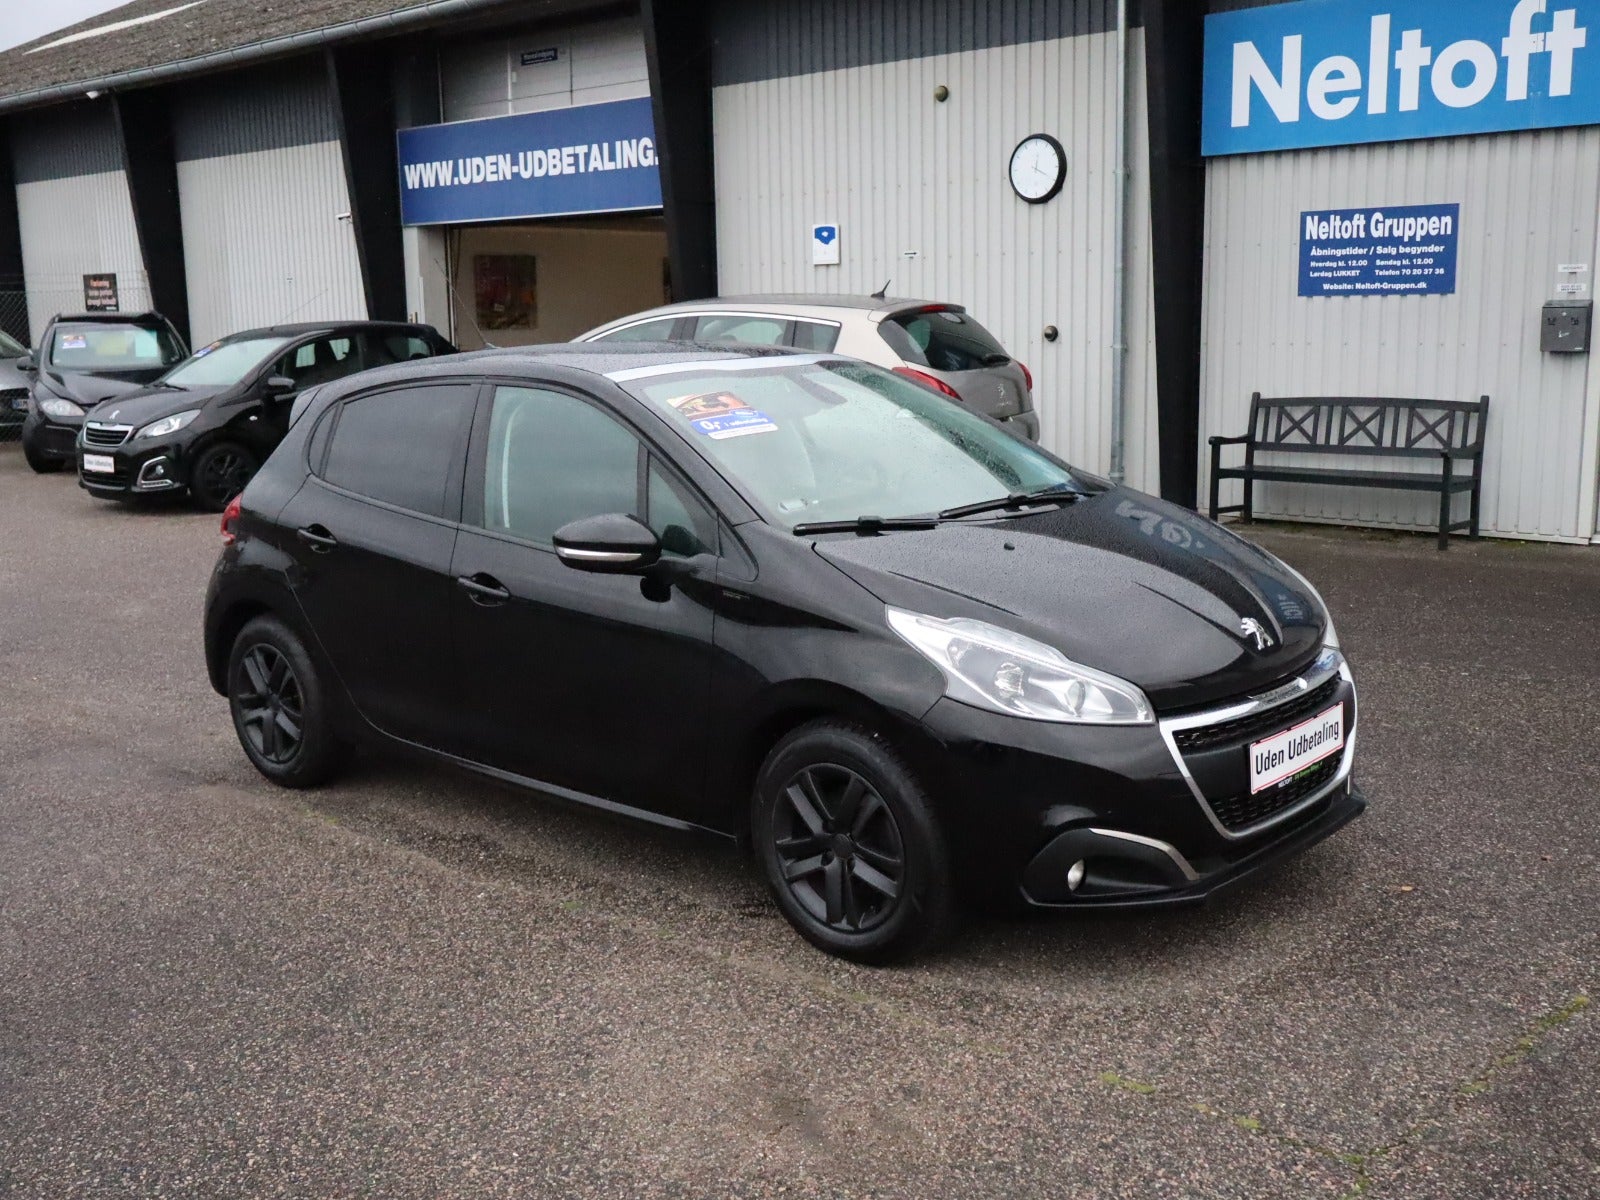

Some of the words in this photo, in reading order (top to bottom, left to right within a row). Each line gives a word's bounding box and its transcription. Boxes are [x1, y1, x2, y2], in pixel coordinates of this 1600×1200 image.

[1231, 0, 1587, 128] Neltoft
[404, 137, 659, 189] WWW.UDEN-UDBETALING.
[1305, 213, 1366, 240] Neltoft
[1370, 212, 1453, 242] Gruppen
[1310, 245, 1368, 257] Åbningstider
[1369, 246, 1375, 256] /
[1376, 245, 1397, 255] Salg
[1399, 244, 1445, 255] begynder
[1347, 259, 1368, 267] 12.00
[1412, 257, 1434, 265] 12.00
[1333, 269, 1361, 277] LUKKET
[1355, 281, 1428, 290] Neltoft-Gruppen.dk
[1255, 748, 1285, 775] Uden
[1288, 721, 1339, 761] Udbetaling
